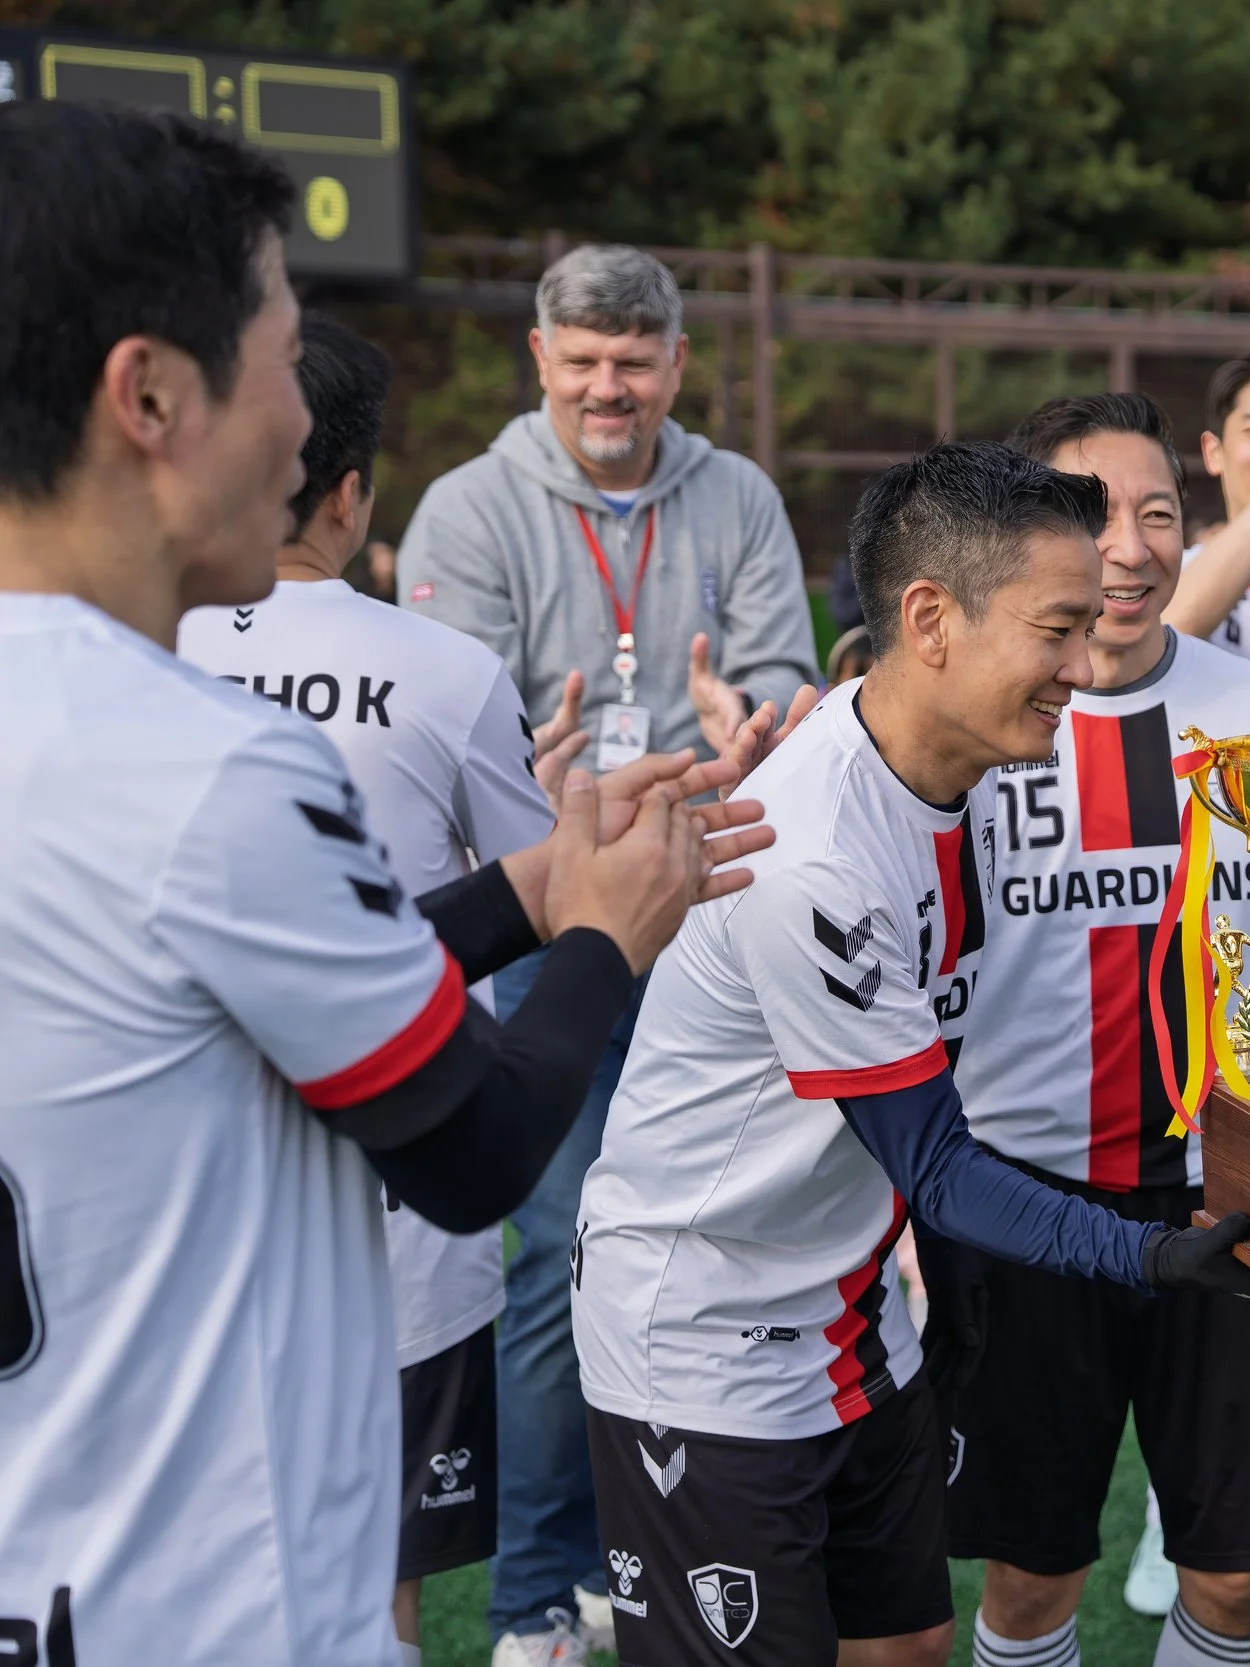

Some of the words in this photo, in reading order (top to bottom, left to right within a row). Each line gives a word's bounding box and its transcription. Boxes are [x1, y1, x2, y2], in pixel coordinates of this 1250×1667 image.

[304, 175, 350, 241] 0
[215, 673, 340, 722] HO
[356, 676, 396, 727] K
[997, 775, 1064, 852] 15
